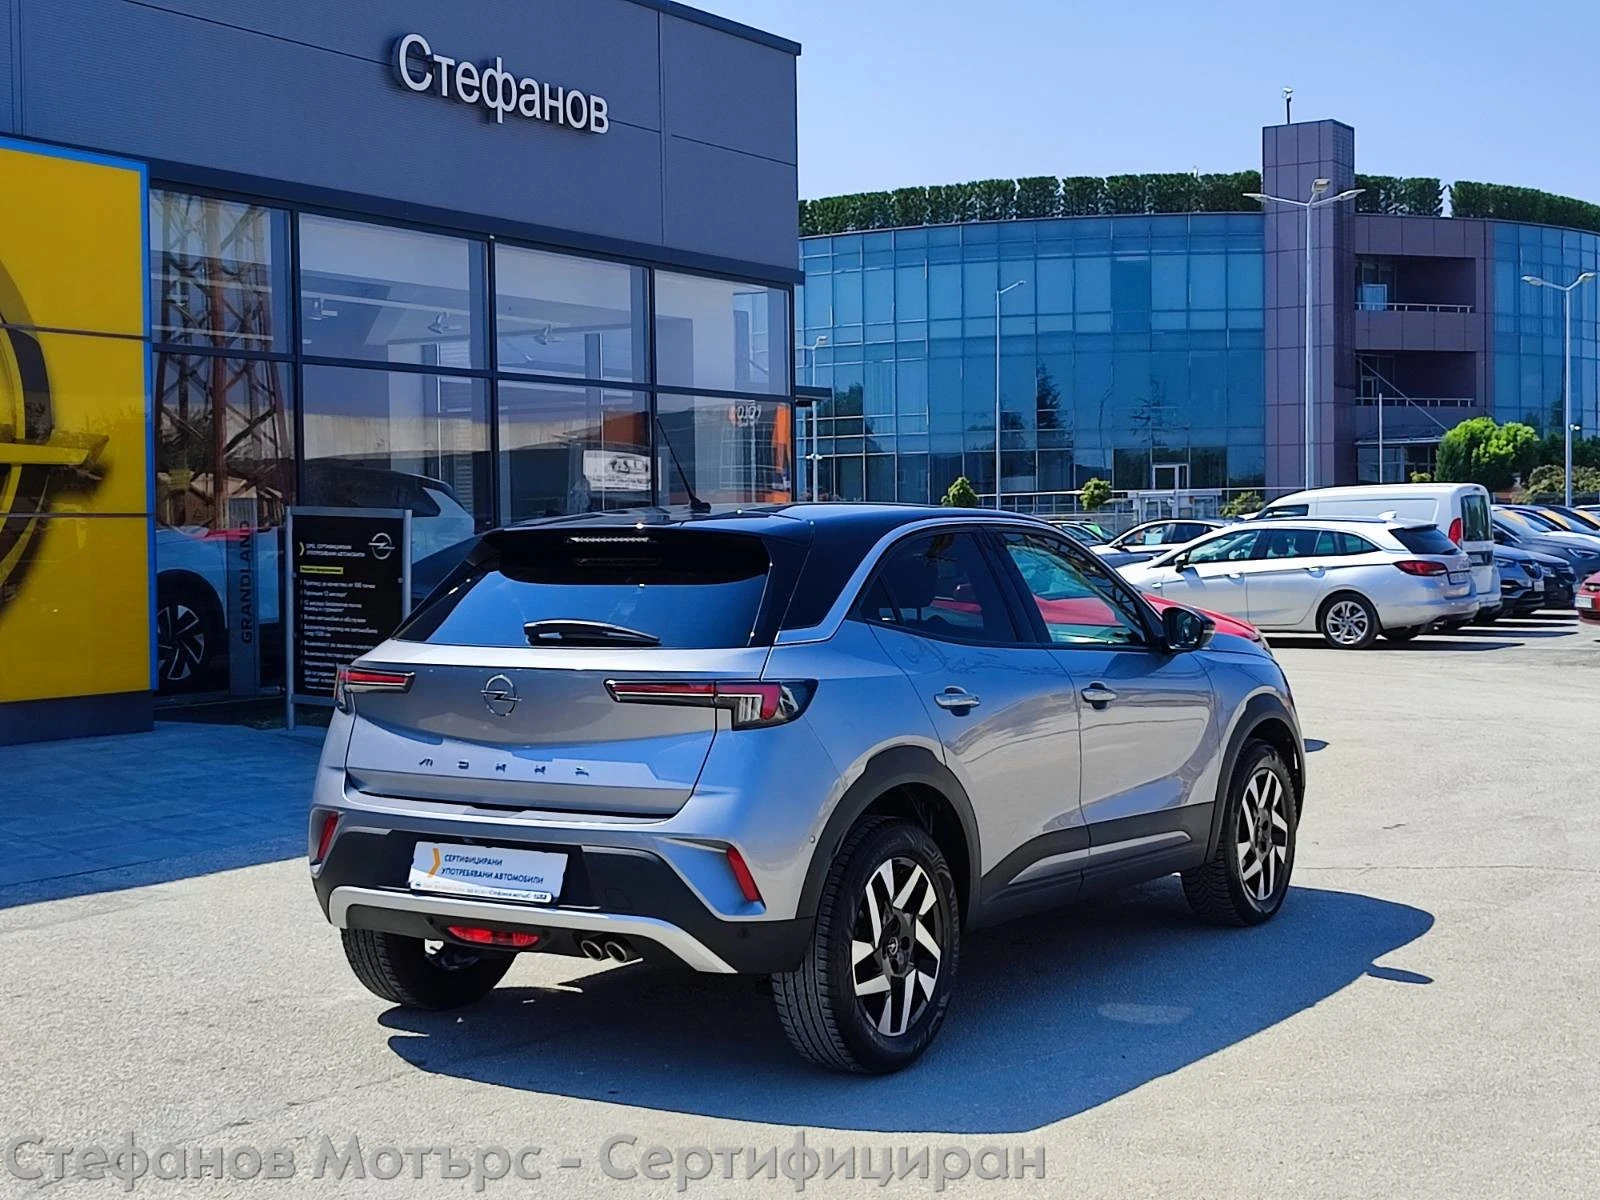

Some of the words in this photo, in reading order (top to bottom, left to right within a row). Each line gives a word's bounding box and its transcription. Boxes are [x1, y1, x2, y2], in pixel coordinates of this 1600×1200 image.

[398, 33, 610, 135] Стефанов
[240, 520, 253, 644] GRANDLAND
[441, 867, 494, 880] УПОТРЕБЯВАНИ
[494, 872, 544, 885] АВТОМОБИЛИ
[444, 853, 503, 867] СЕРТИФИЦИРАНИ
